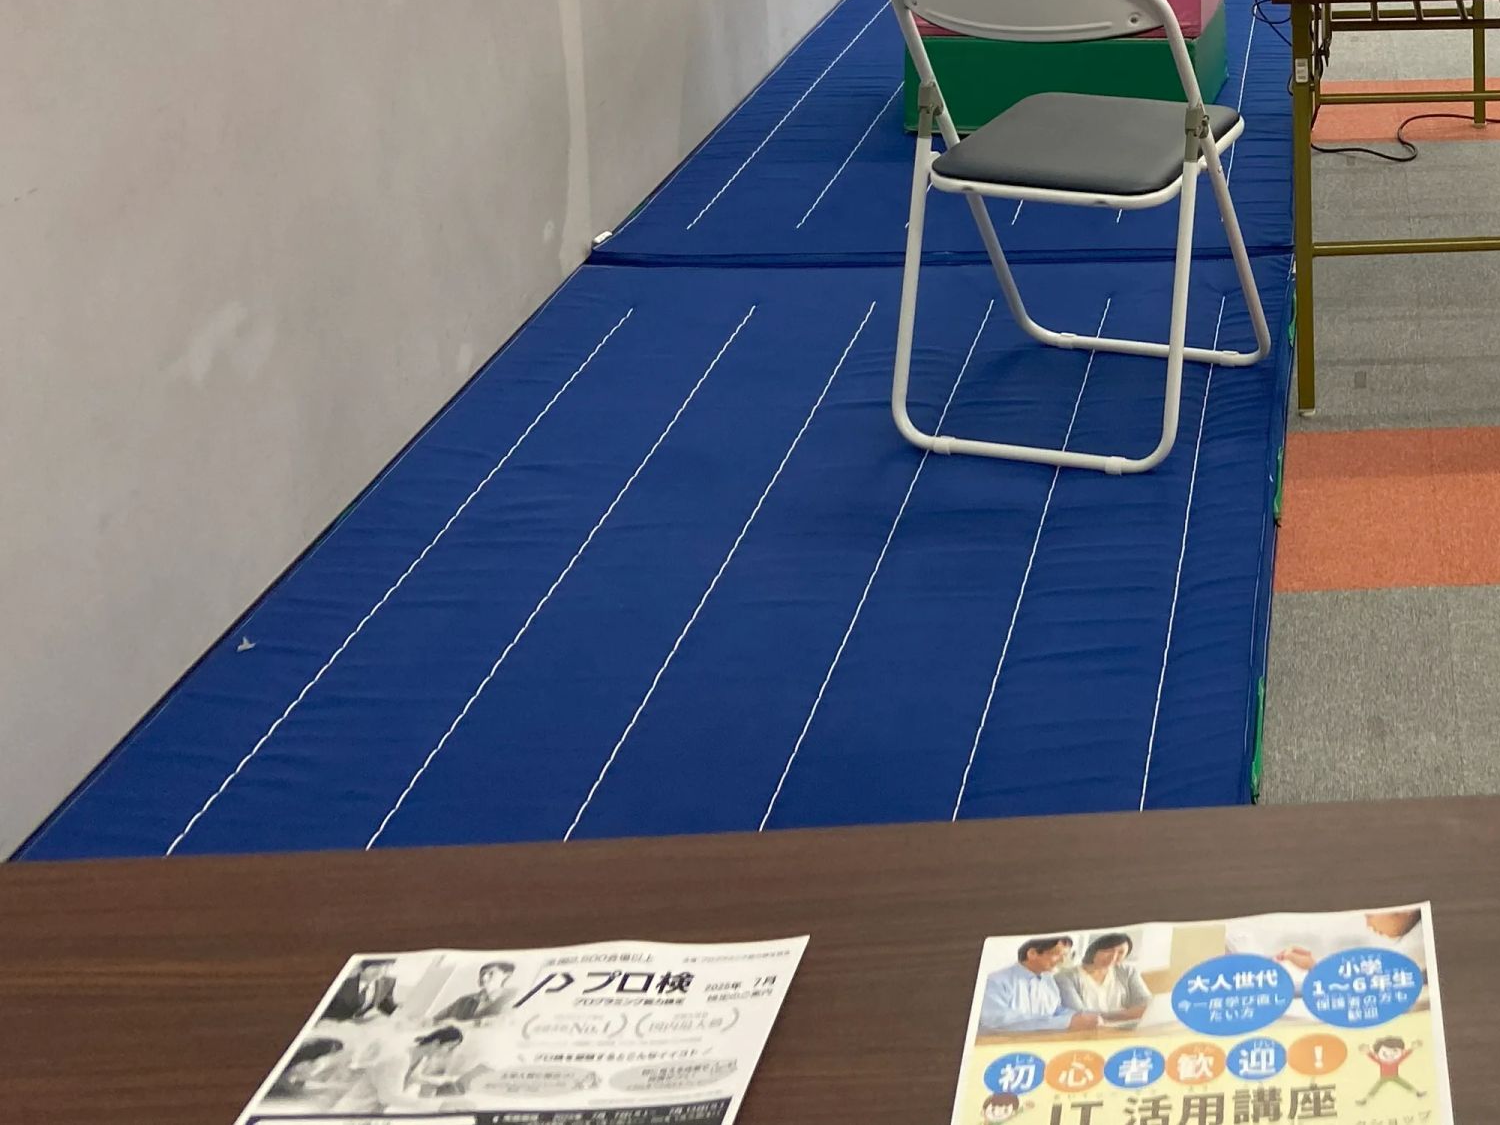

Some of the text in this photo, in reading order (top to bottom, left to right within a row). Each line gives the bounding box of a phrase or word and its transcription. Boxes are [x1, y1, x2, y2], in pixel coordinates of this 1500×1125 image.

[1338, 959, 1383, 976] 小学
[582, 969, 696, 994] プロ検
[753, 974, 778, 987] 7月
[1187, 969, 1279, 994] 大人世代
[1178, 993, 1287, 1012] 今一度学び直し
[1316, 990, 1409, 1012] 保護者の方も
[1210, 1008, 1255, 1022] たい方
[1124, 1083, 1338, 1125] 活用講座
